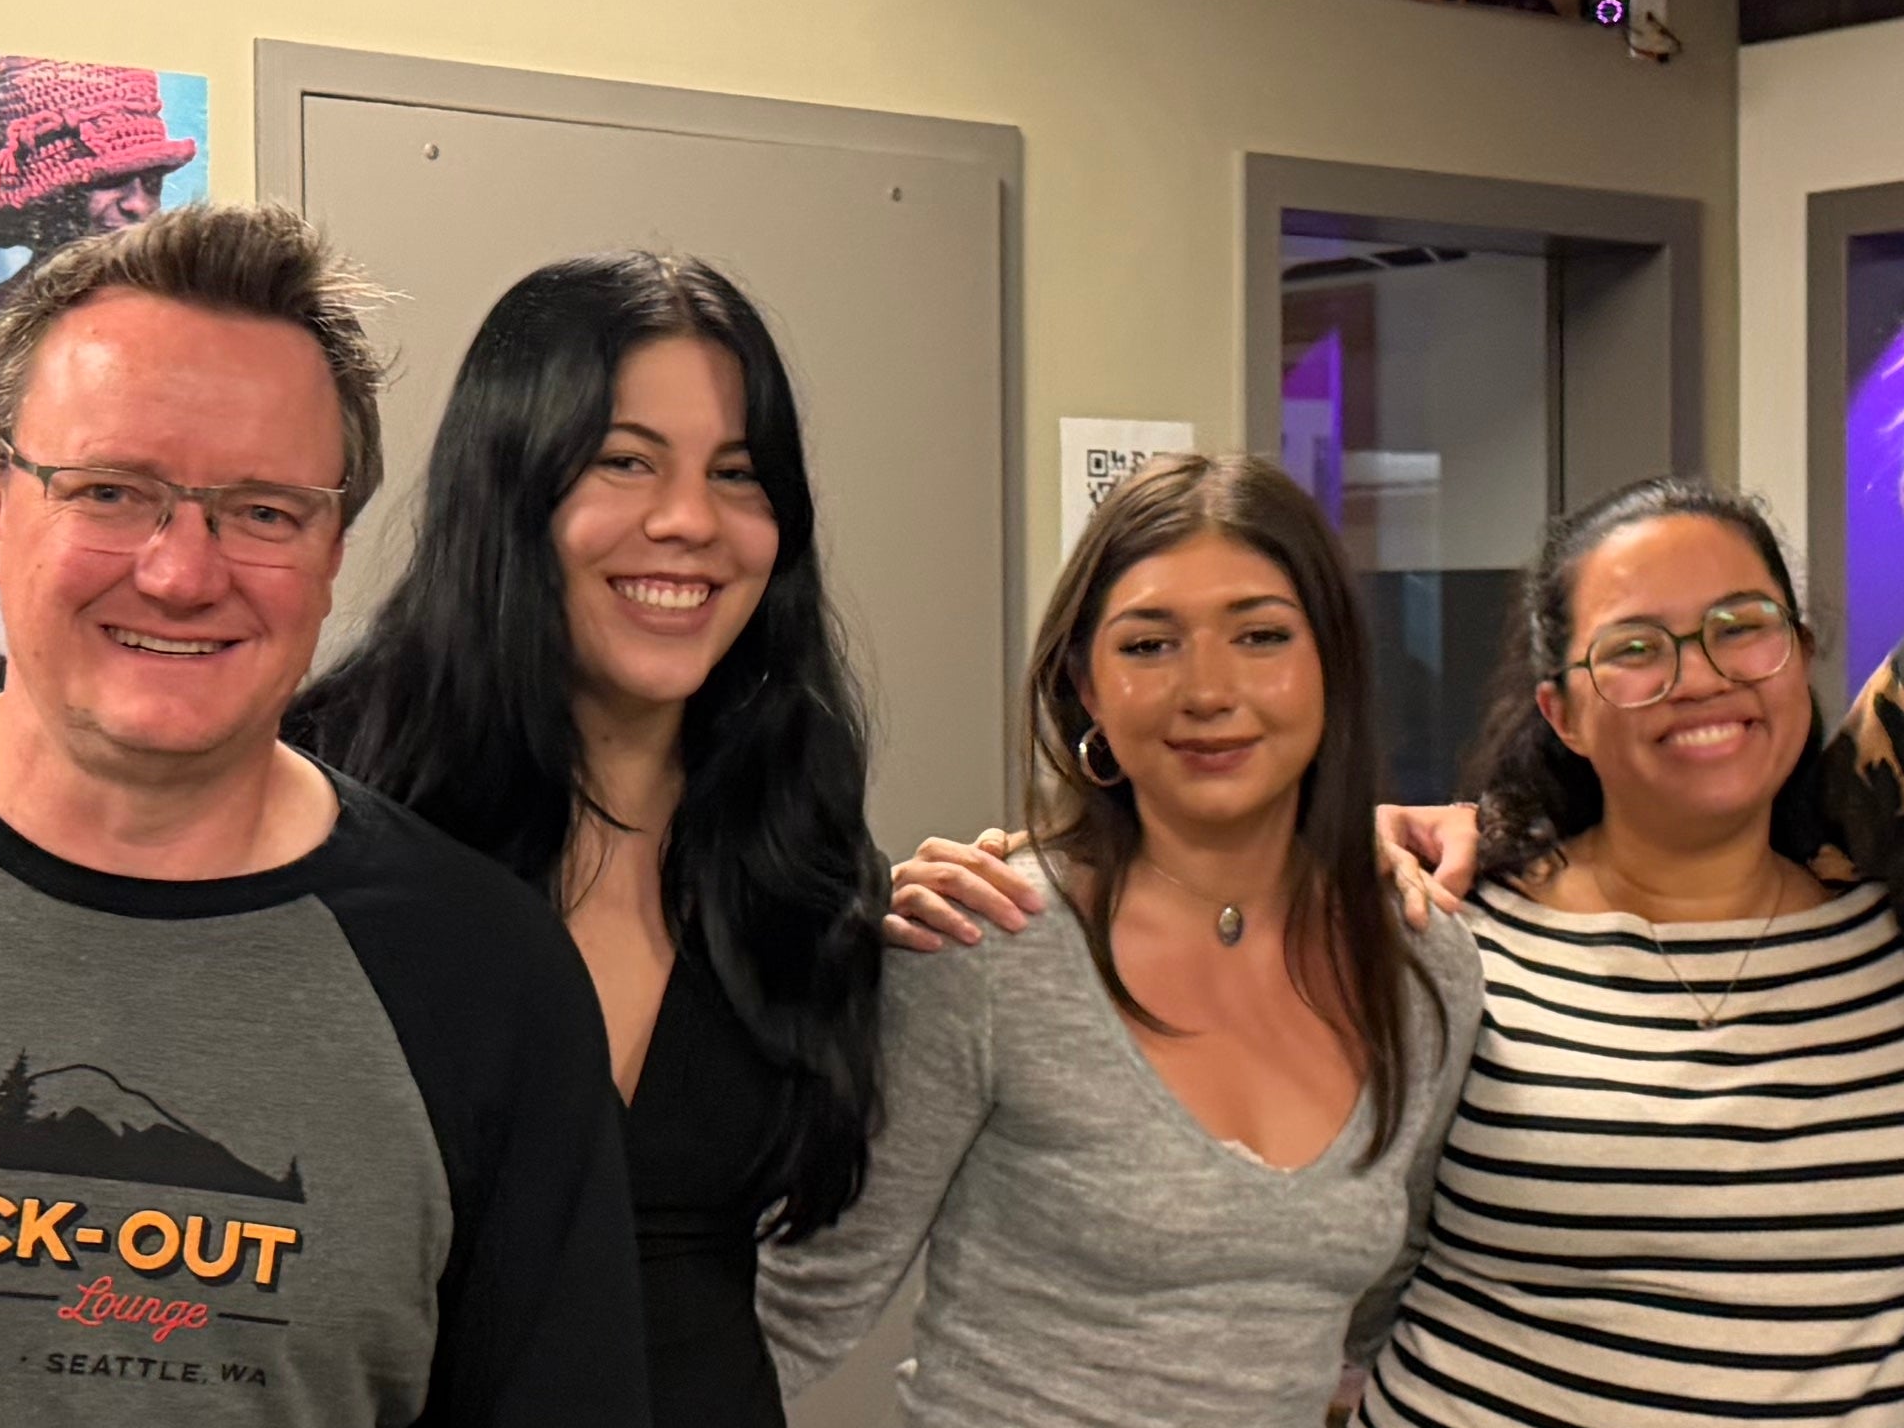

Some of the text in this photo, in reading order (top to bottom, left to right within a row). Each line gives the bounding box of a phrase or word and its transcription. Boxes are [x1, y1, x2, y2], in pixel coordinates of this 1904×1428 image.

[58, 1275, 209, 1343] Lounge
[45, 1352, 209, 1386] SEATTLE,
[219, 1363, 268, 1388] WA
